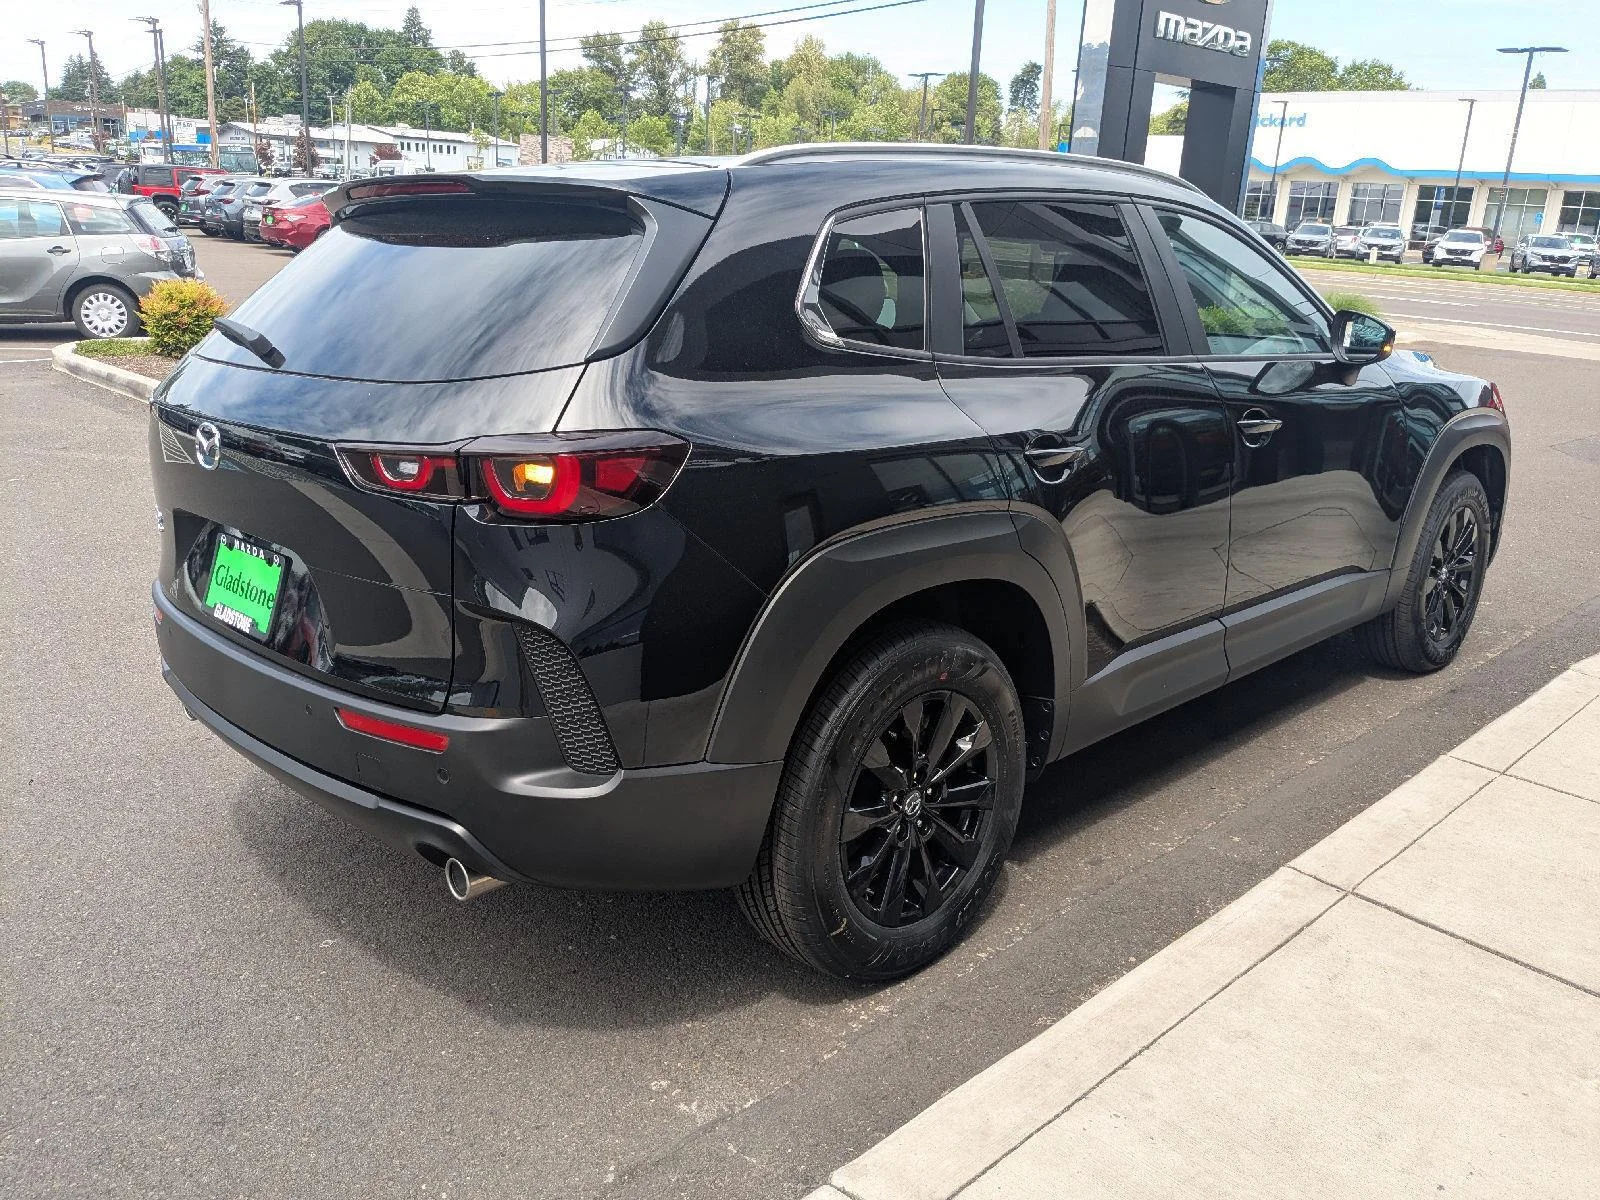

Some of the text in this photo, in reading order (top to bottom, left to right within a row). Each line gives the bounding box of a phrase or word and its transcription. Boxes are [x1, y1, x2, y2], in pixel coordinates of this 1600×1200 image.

[234, 538, 265, 560] MAZDA
[215, 564, 275, 610] Gladstone
[213, 602, 253, 634] GLADSTONE
